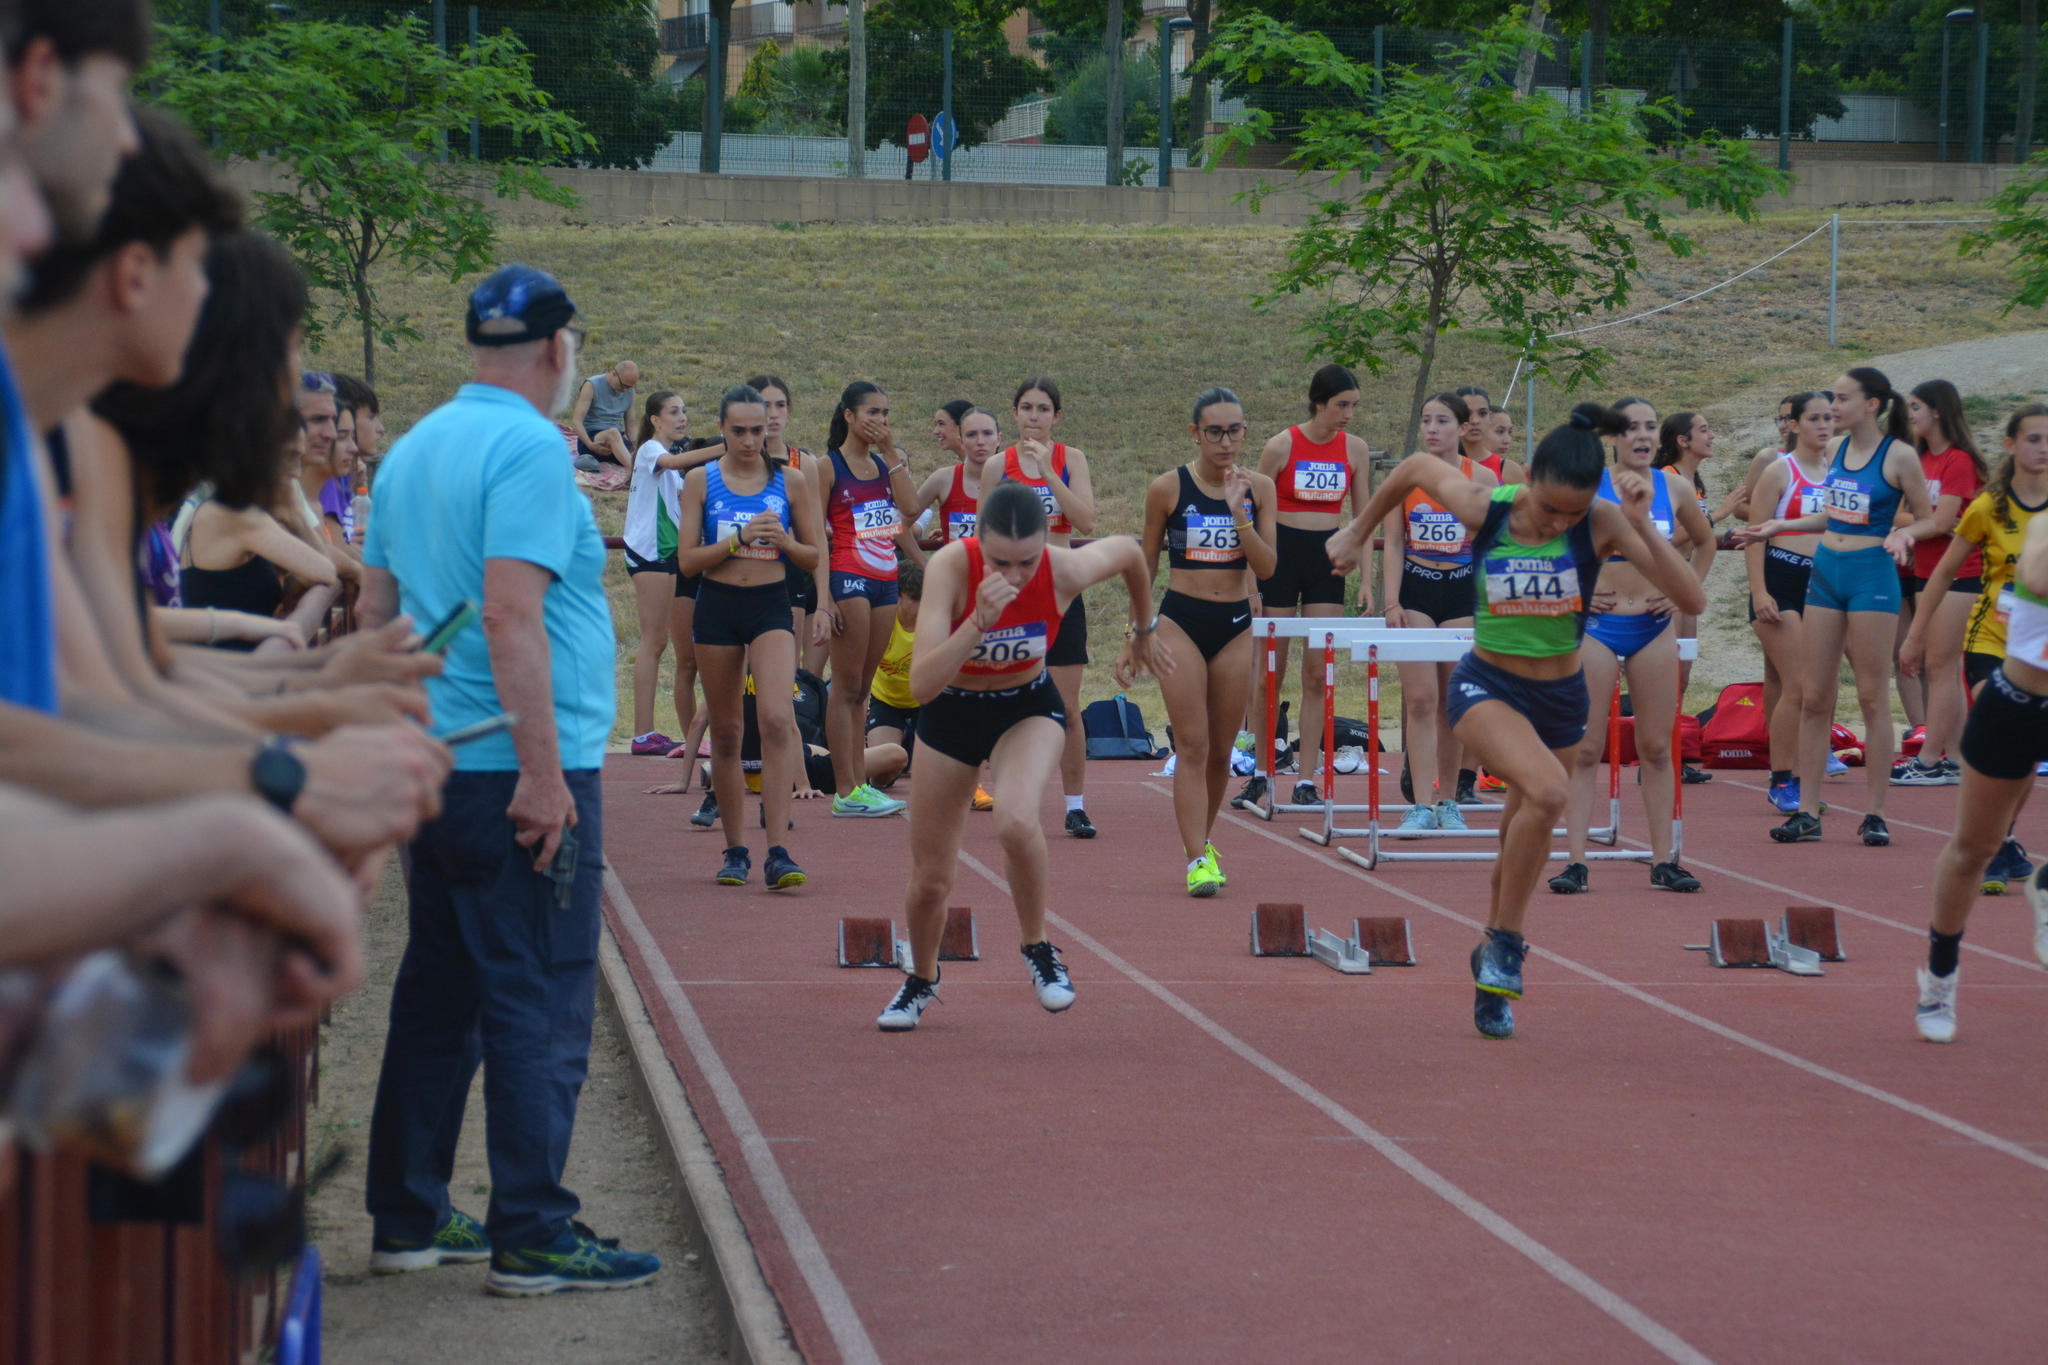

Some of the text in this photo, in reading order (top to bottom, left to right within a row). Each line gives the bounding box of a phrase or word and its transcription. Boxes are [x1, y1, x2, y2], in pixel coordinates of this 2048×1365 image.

[1304, 472, 1339, 490] 204
[1829, 490, 1859, 511] 116
[864, 509, 893, 528] 286
[1198, 529, 1241, 548] 263
[1418, 524, 1456, 541] 266
[1768, 548, 1801, 566] NIKE
[1411, 565, 1444, 580] PRO
[1449, 563, 1473, 580] NIK
[1503, 575, 1565, 601] 144
[970, 640, 1031, 662] 206
